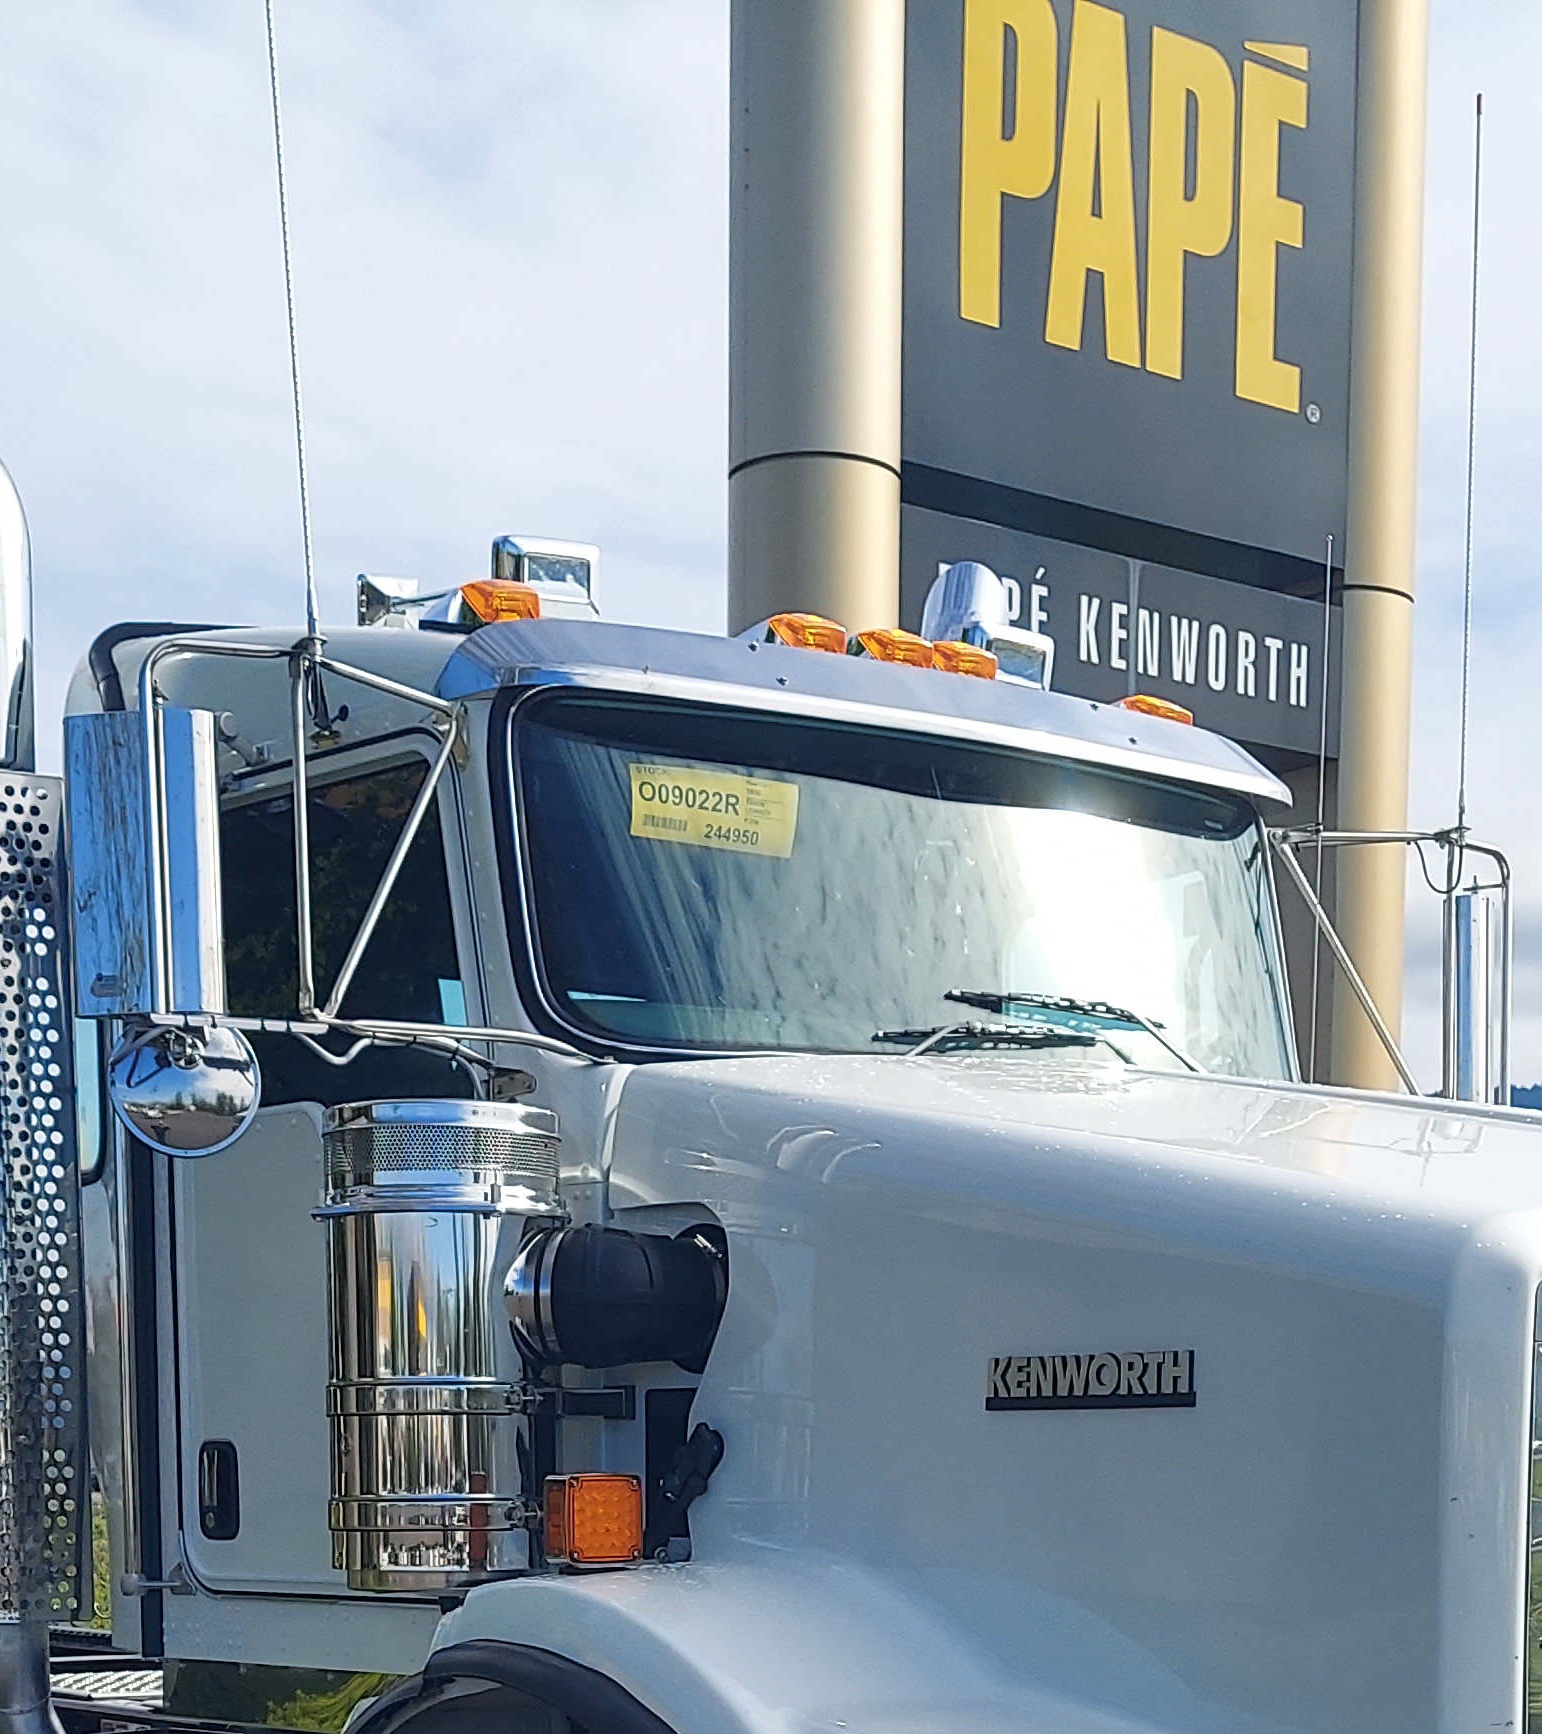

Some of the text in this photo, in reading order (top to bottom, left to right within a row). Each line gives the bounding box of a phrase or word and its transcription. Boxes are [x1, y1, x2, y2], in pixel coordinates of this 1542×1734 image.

[1079, 594, 1309, 709] KENWORTH
[704, 823, 759, 846] 244950
[986, 1350, 1195, 1399] KENWORTH
